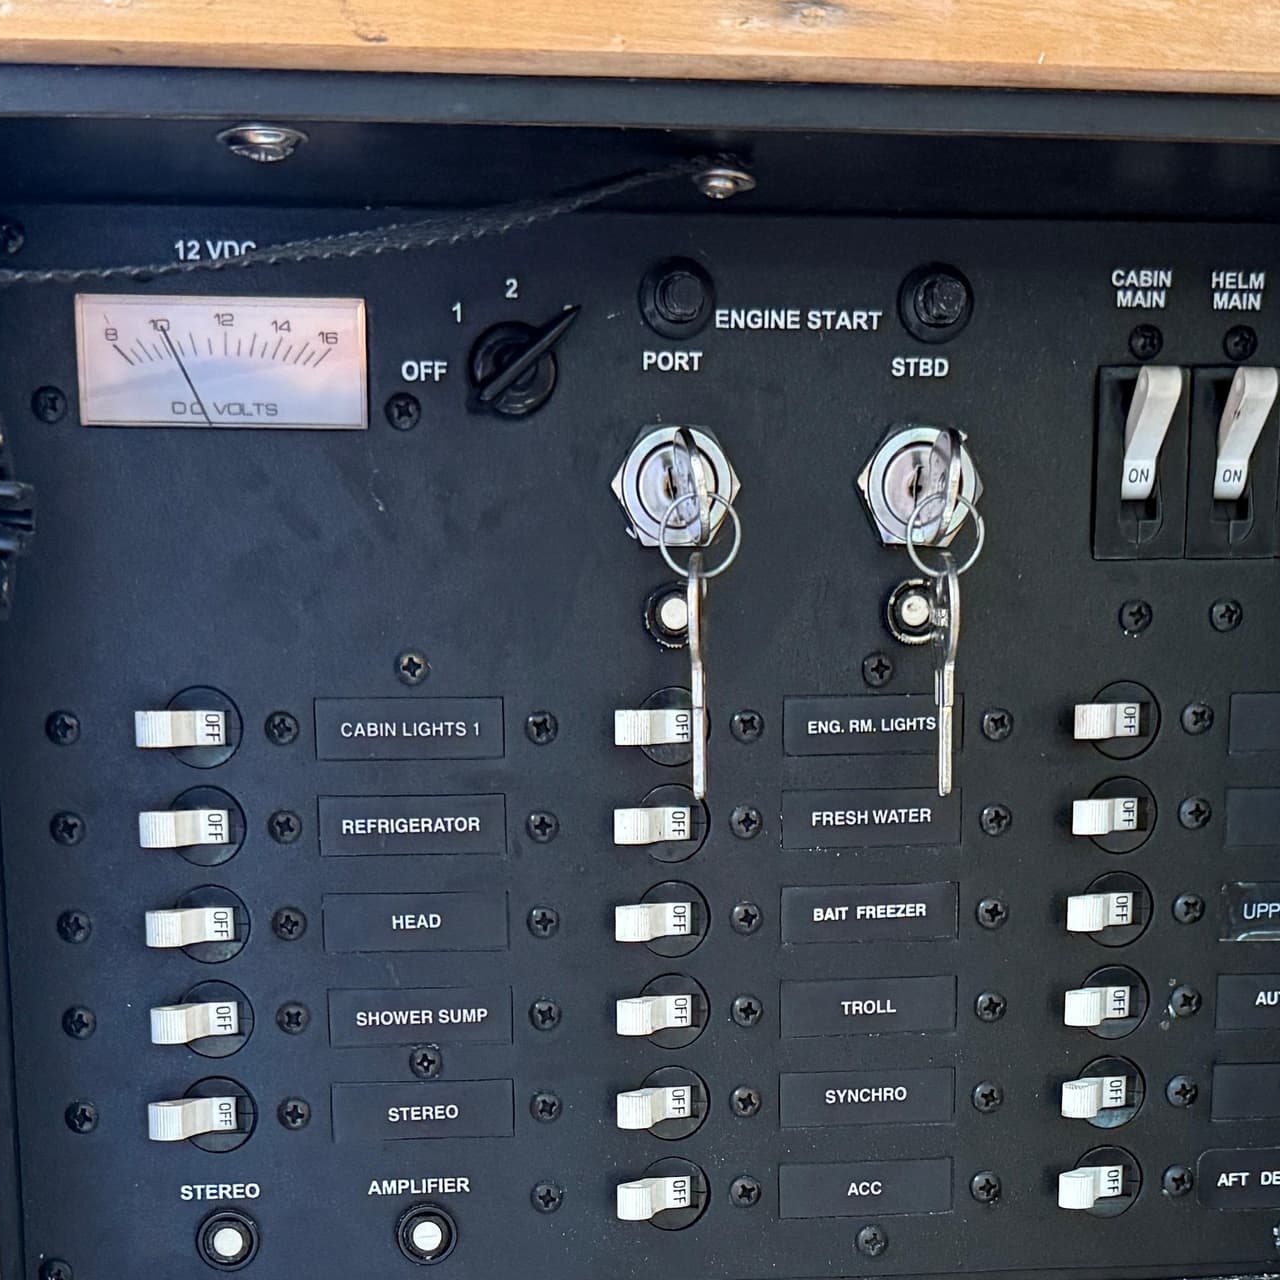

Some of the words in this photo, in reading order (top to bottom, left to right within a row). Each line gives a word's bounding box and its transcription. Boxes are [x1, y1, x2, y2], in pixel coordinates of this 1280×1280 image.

[174, 239, 201, 260] 12
[1111, 269, 1172, 288] CABIN
[1211, 272, 1265, 290] HELM
[506, 278, 519, 299] 2
[1116, 290, 1165, 308] MAIN
[1213, 293, 1261, 310] MAIN
[214, 313, 234, 327] 12
[451, 303, 463, 322] 1
[714, 309, 800, 330] ENGINE
[807, 311, 882, 330] START
[104, 327, 118, 341] 8
[148, 319, 170, 332] 10
[272, 320, 291, 332] 14
[318, 331, 338, 345] 16
[642, 351, 703, 371] PORT
[891, 357, 949, 377] STBD
[401, 360, 447, 381] OFF
[171, 401, 204, 416] DC
[213, 402, 279, 416] VOLTS
[1127, 468, 1150, 484] ON
[1222, 469, 1242, 484] ON
[204, 713, 221, 742] OFF
[340, 722, 398, 738] CABIN
[402, 721, 469, 737] LIGHTS
[472, 722, 481, 737] 1
[807, 719, 845, 735] ENG.
[849, 719, 877, 733] RM.
[881, 717, 936, 732] LIGHTS
[671, 809, 686, 836] OFF
[811, 811, 869, 827] FRESH
[872, 808, 932, 825] WATER
[1122, 801, 1136, 827] OFF
[341, 817, 481, 835] REFRIGERATOR
[812, 907, 848, 921] BAIT
[856, 903, 927, 920] FREEZER
[391, 913, 441, 931] HEAD
[840, 999, 897, 1016] TROLL
[215, 1005, 232, 1032] OFF
[356, 1010, 433, 1027] SHOWER
[438, 1008, 488, 1025] SUMP
[825, 1086, 907, 1104] SYNCHRO
[1108, 1079, 1122, 1104] OFF
[671, 1088, 686, 1116] OFF
[387, 1105, 459, 1122] STEREO
[367, 1177, 471, 1196] AMPLIFIER
[847, 1180, 883, 1196] ACC
[1217, 1172, 1250, 1187] AFT
[180, 1182, 261, 1201] STEREO
